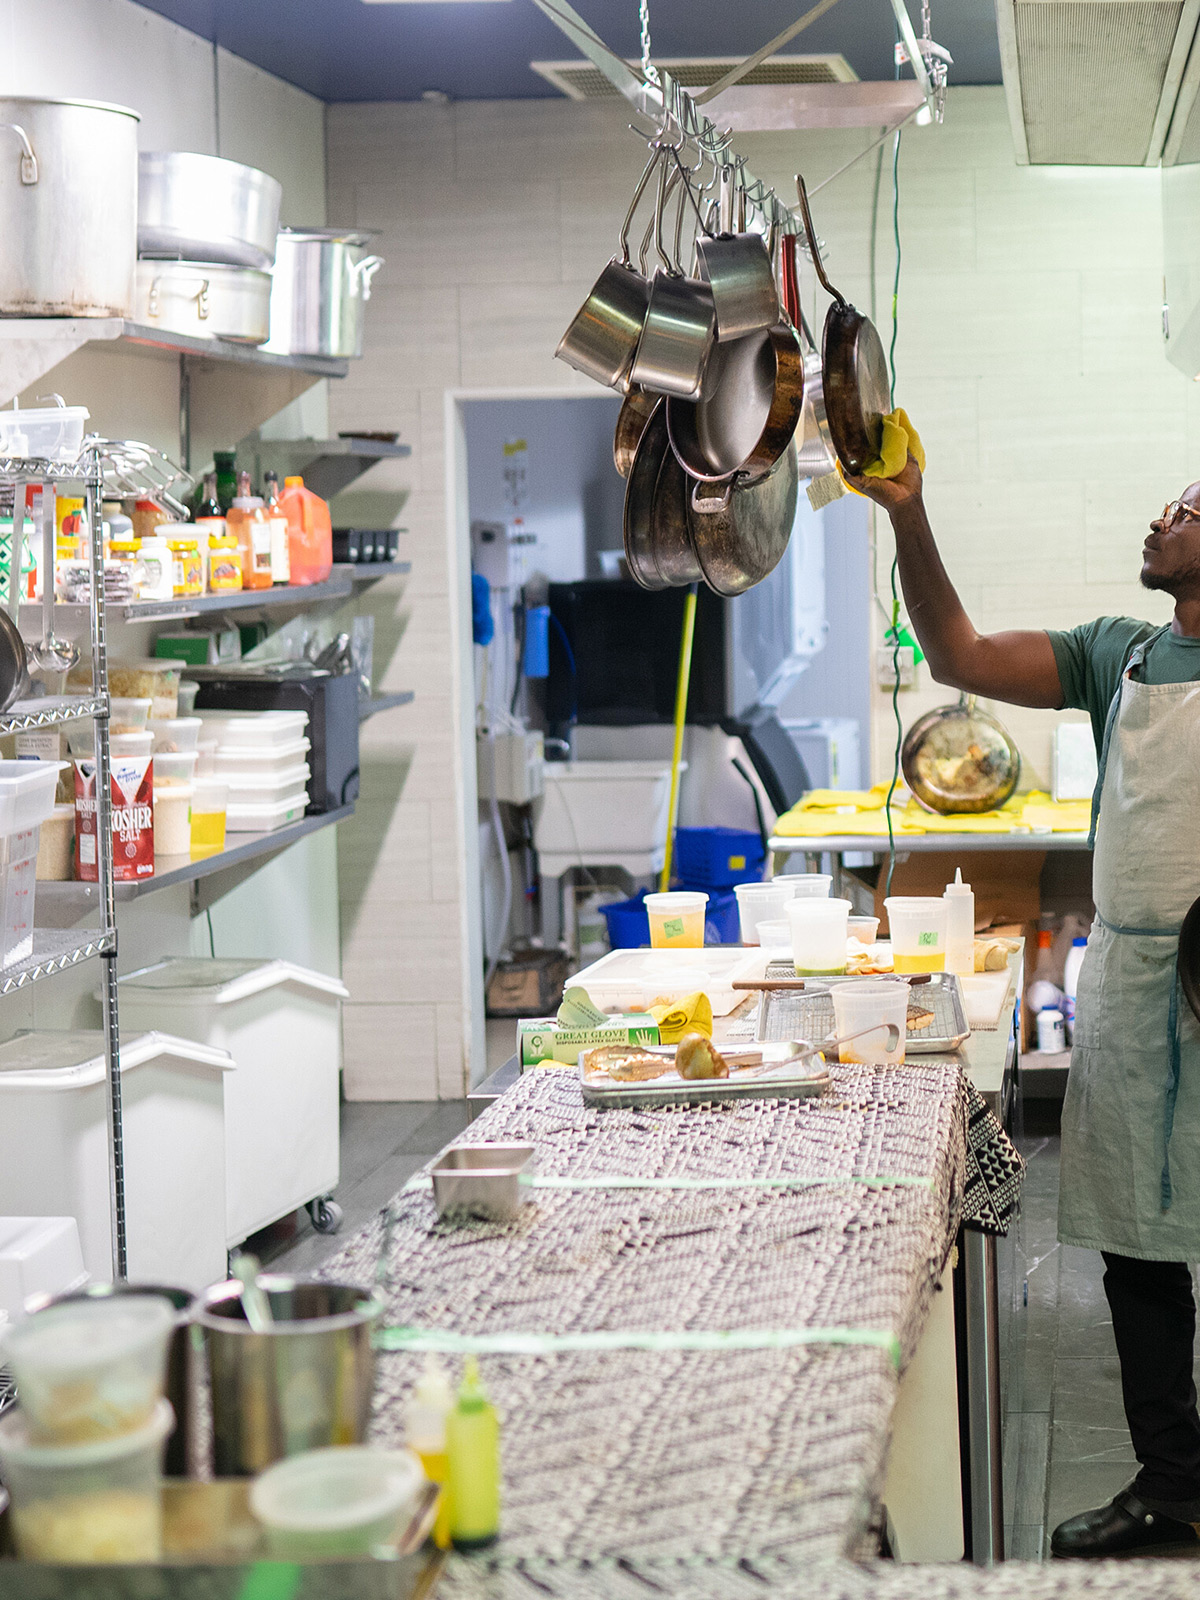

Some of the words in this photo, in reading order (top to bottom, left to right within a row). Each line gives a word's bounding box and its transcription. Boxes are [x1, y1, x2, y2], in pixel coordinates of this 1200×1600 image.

[120, 829, 141, 842] SALT
[555, 1031, 589, 1040] GREAT
[591, 1028, 626, 1039] GLOVE
